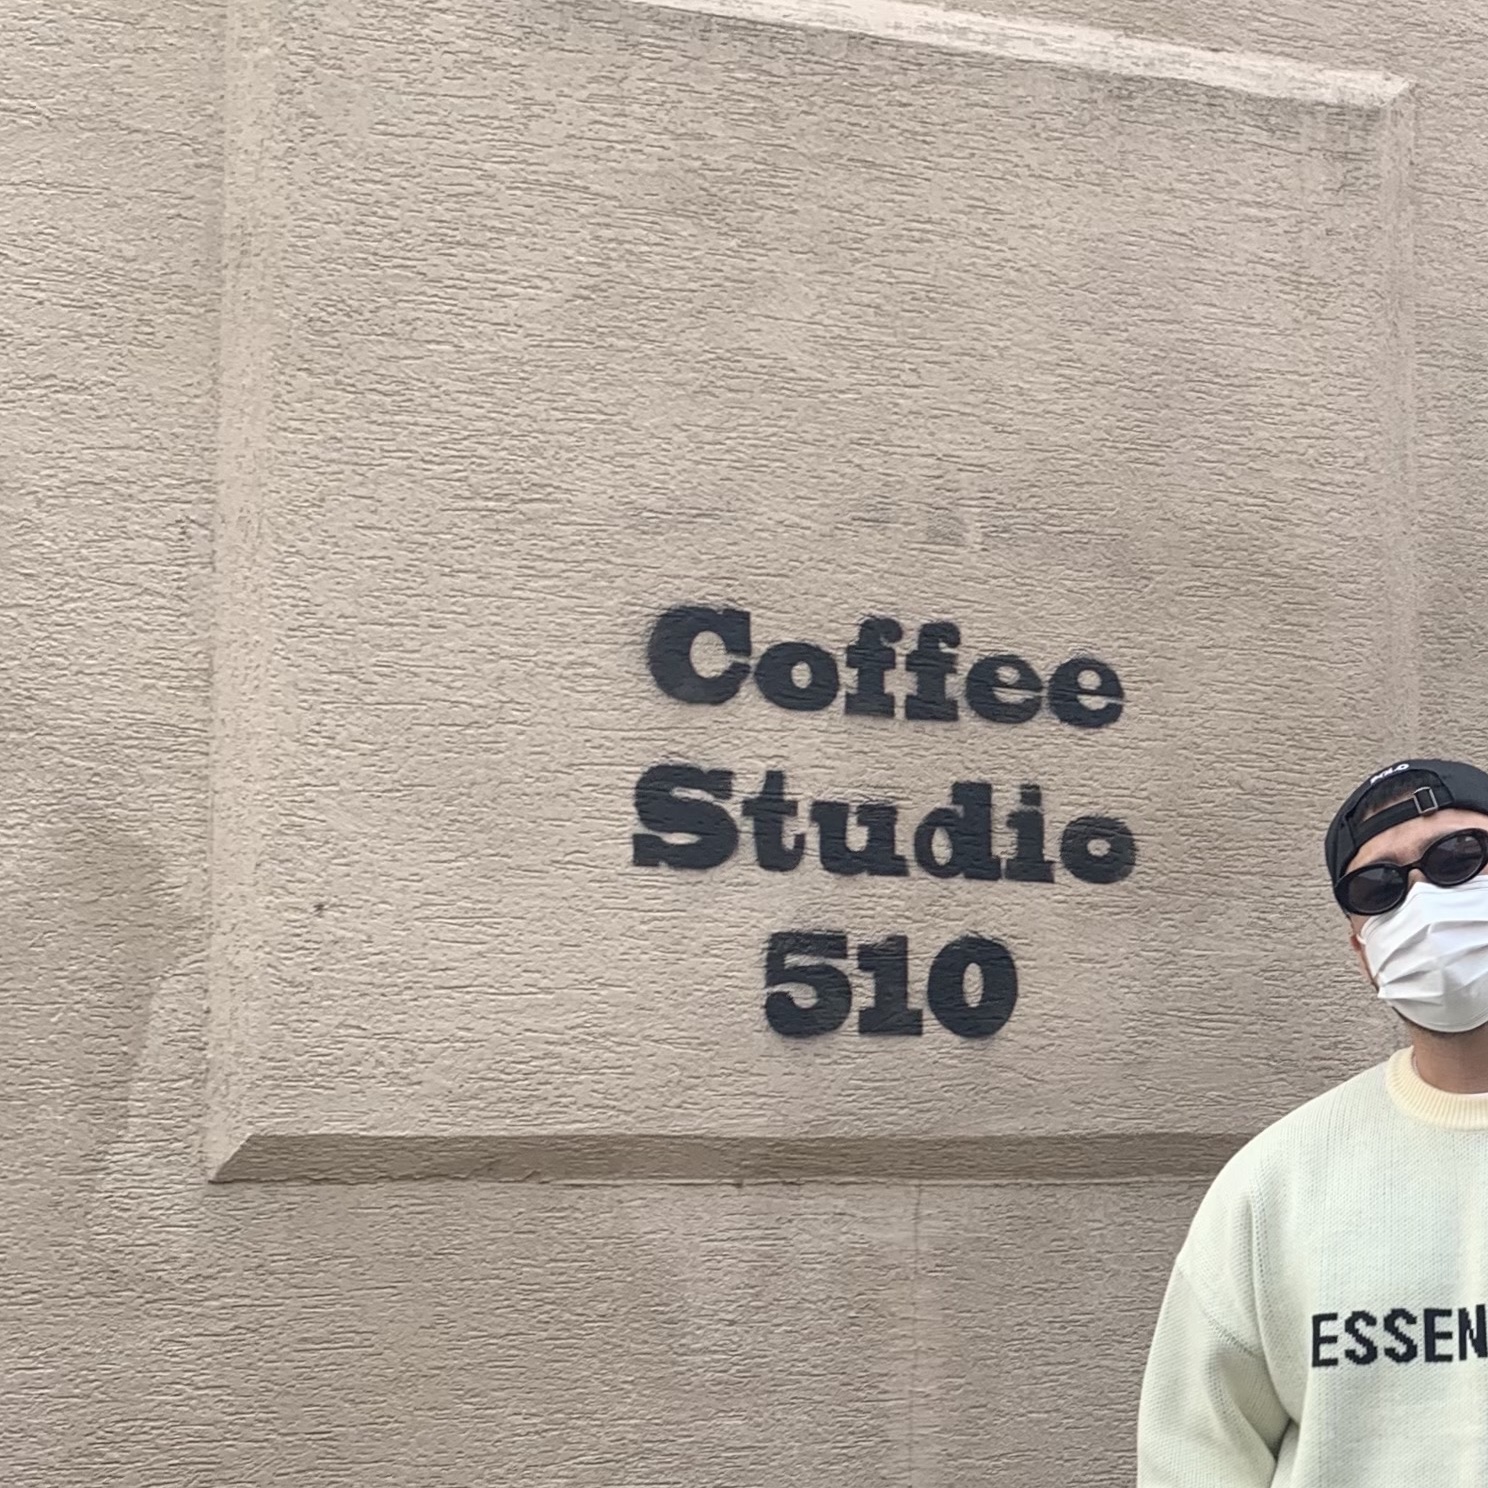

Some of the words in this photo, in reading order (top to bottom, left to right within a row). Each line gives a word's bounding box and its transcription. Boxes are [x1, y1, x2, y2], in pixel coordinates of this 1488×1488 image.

[646, 605, 1126, 729] Coffee
[632, 763, 1139, 885] Studio
[763, 931, 1018, 1039] 510
